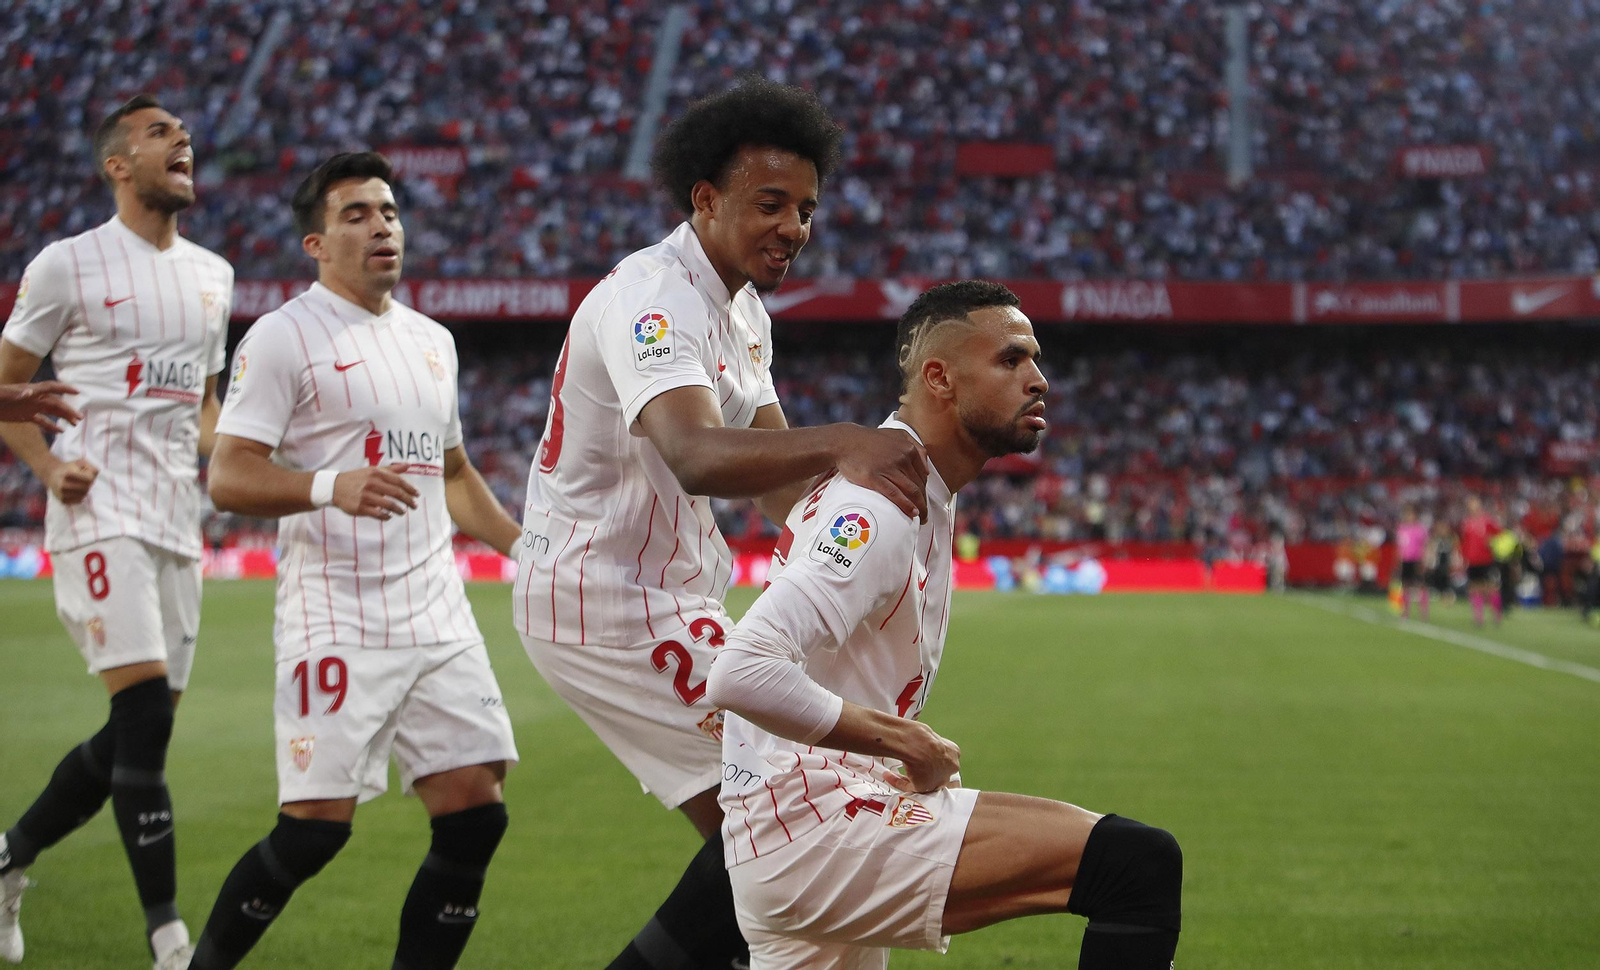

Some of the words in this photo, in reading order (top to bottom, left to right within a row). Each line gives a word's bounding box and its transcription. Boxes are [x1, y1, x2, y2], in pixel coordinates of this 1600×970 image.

[638, 346, 671, 361] LaLiga
[817, 541, 853, 568] LaLiga
[84, 551, 110, 600] 8
[292, 656, 348, 718] 19
[722, 761, 762, 788] om
